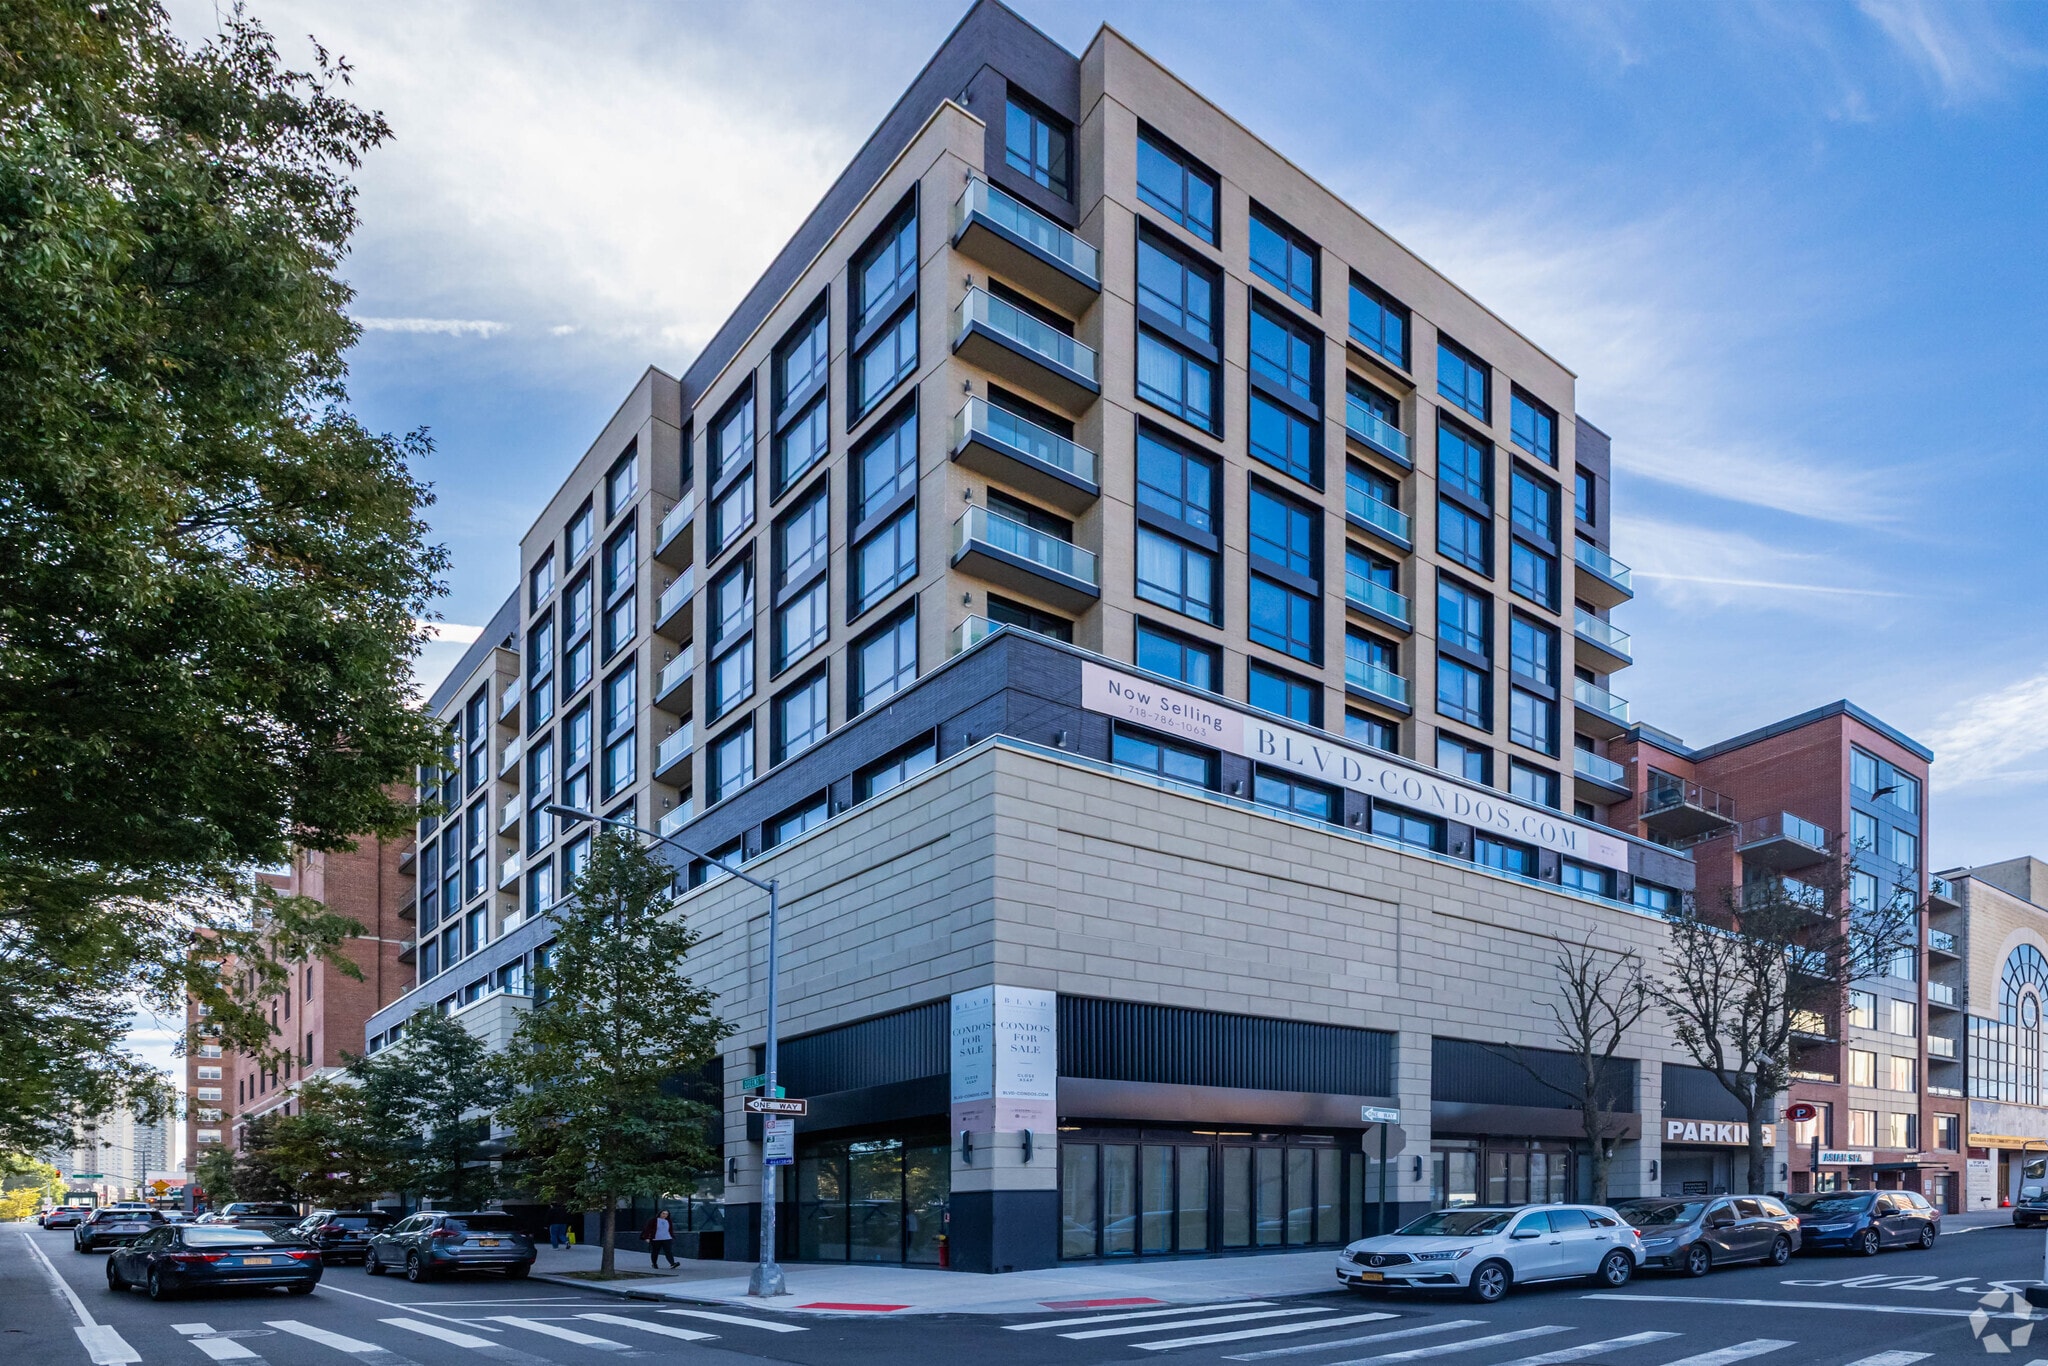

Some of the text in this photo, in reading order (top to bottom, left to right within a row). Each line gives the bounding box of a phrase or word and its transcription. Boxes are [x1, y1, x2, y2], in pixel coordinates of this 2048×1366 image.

[1109, 680, 1223, 731] Now Selling
[1128, 705, 1207, 736] 718-786-1063
[1256, 727, 1577, 850] BLVD-CONDOS.COM
[953, 1021, 991, 1036] CONDOS
[1001, 1021, 1050, 1033] CONDOS
[962, 1035, 981, 1046] FOR
[1014, 1033, 1037, 1043] FOR
[959, 1045, 984, 1057] SALE
[1010, 1045, 1041, 1054] SALE
[753, 1101, 771, 1109] ONE
[1796, 1109, 1806, 1117] P
[1667, 1120, 1772, 1145] PARKING
[1823, 1153, 1863, 1162] ASIAN SPA
[1780, 1274, 2046, 1294] STOP
